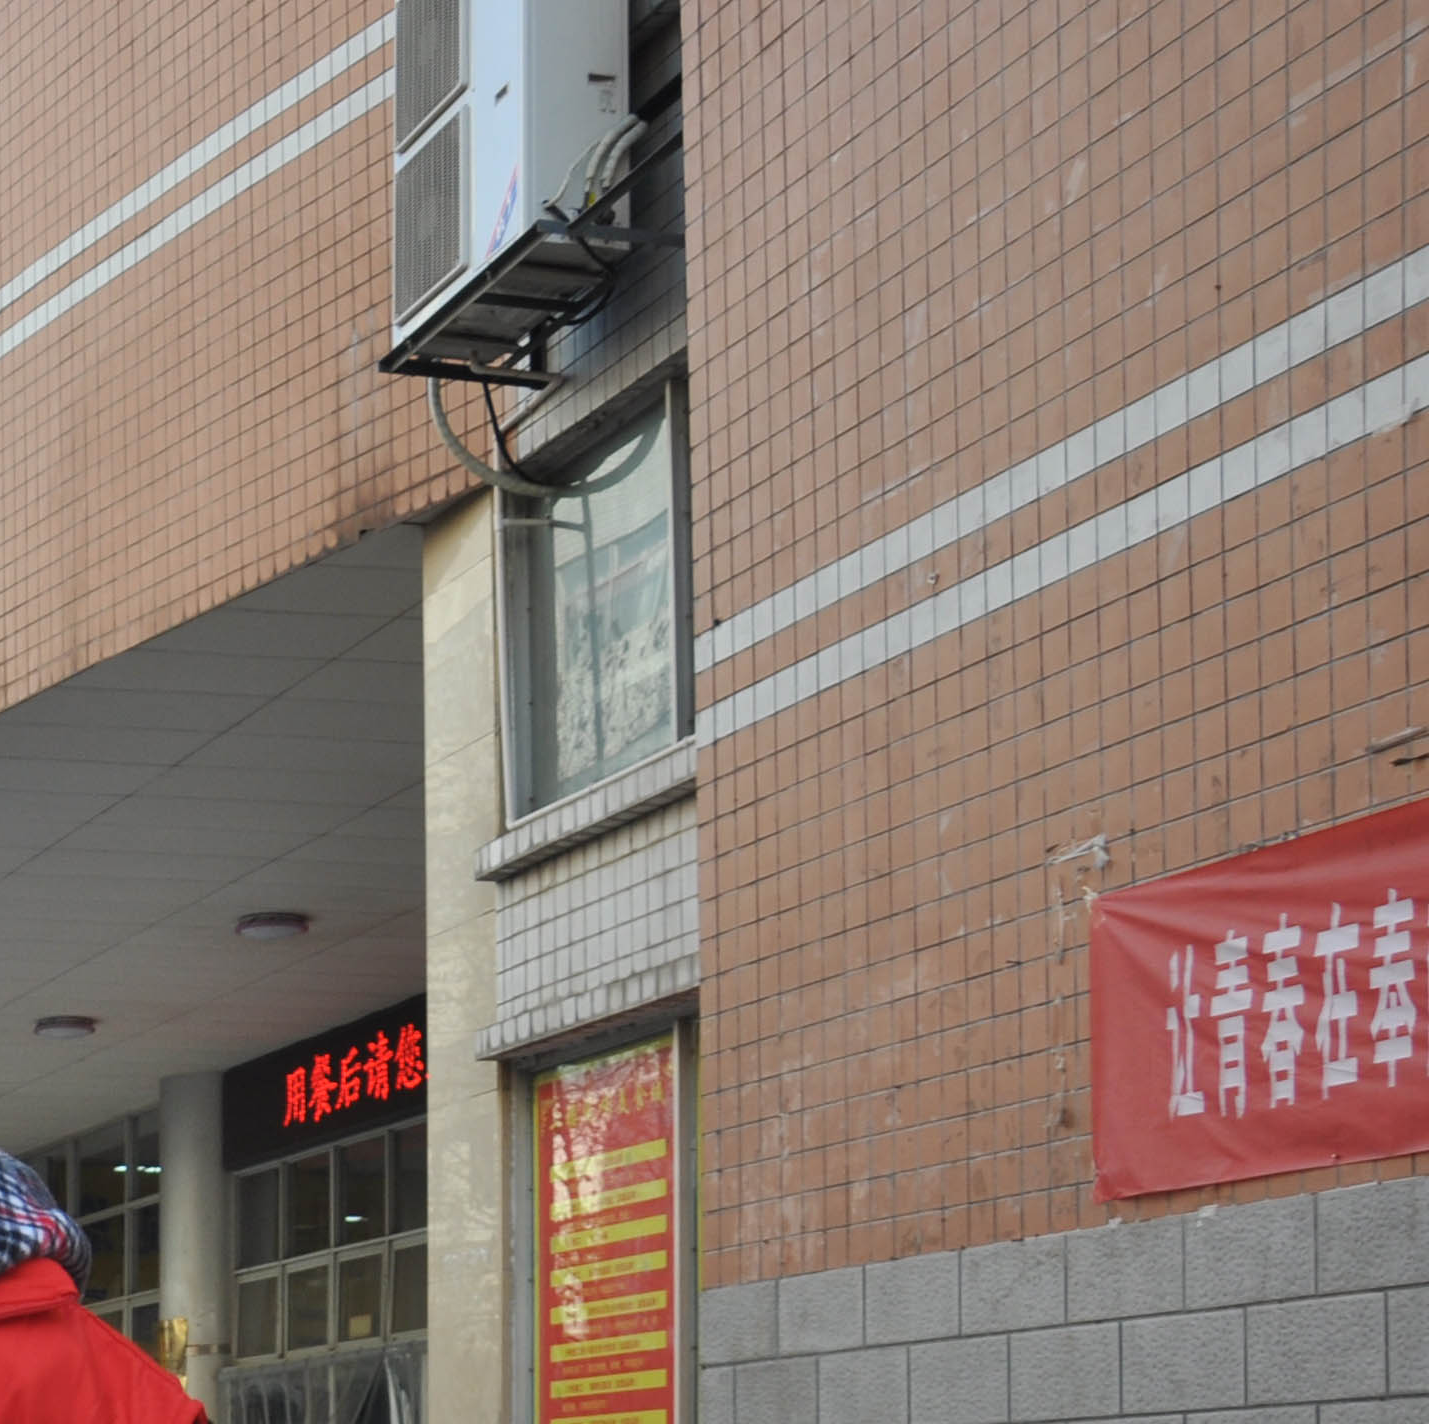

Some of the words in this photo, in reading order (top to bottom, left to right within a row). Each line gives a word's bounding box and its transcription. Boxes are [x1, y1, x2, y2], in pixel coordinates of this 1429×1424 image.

[282, 1024, 425, 1127] 用餐后请您
[1165, 887, 1429, 1121] 让青春在奉
